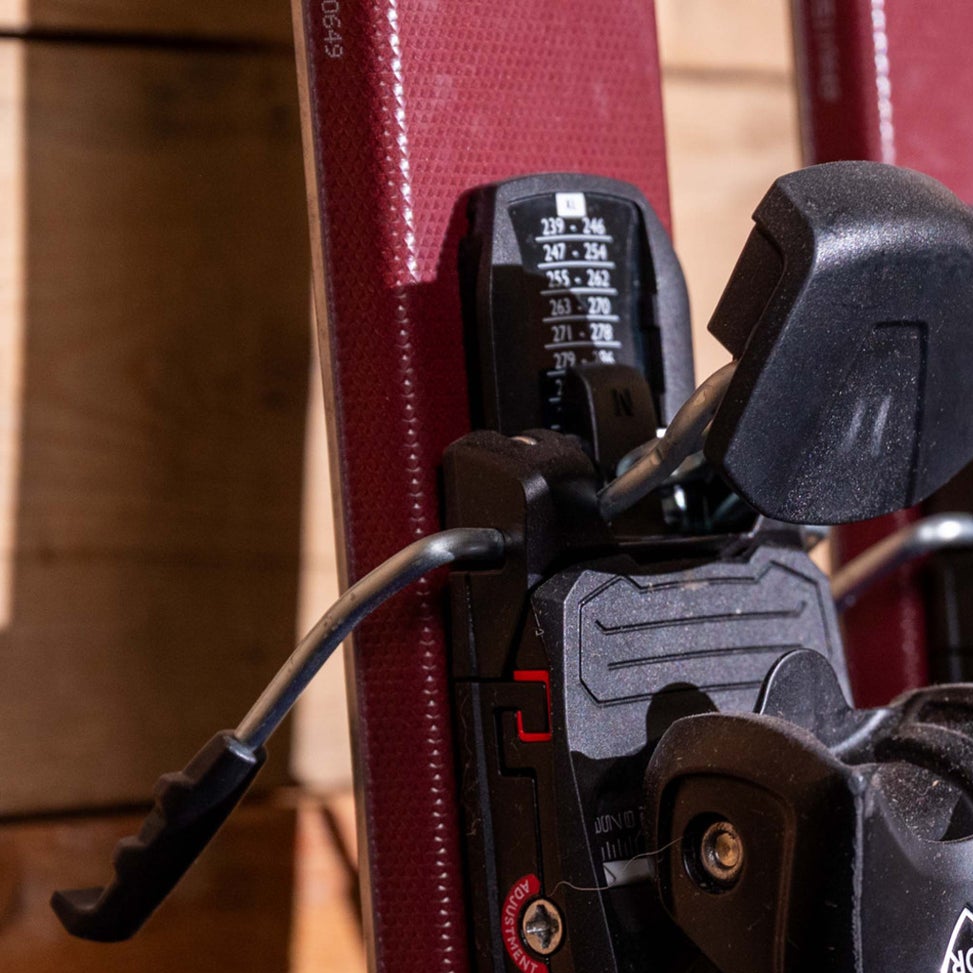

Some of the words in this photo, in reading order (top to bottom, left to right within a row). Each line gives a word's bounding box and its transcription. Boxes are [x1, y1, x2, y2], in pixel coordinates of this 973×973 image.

[541, 218, 565, 235] 239
[582, 217, 606, 235] 246
[543, 243, 566, 262] 247
[583, 242, 608, 261] 254
[546, 269, 571, 288] 255
[586, 268, 611, 287] 262
[549, 297, 571, 316] 263
[587, 296, 612, 315] 270
[551, 324, 573, 343] 271
[589, 322, 614, 342] 278
